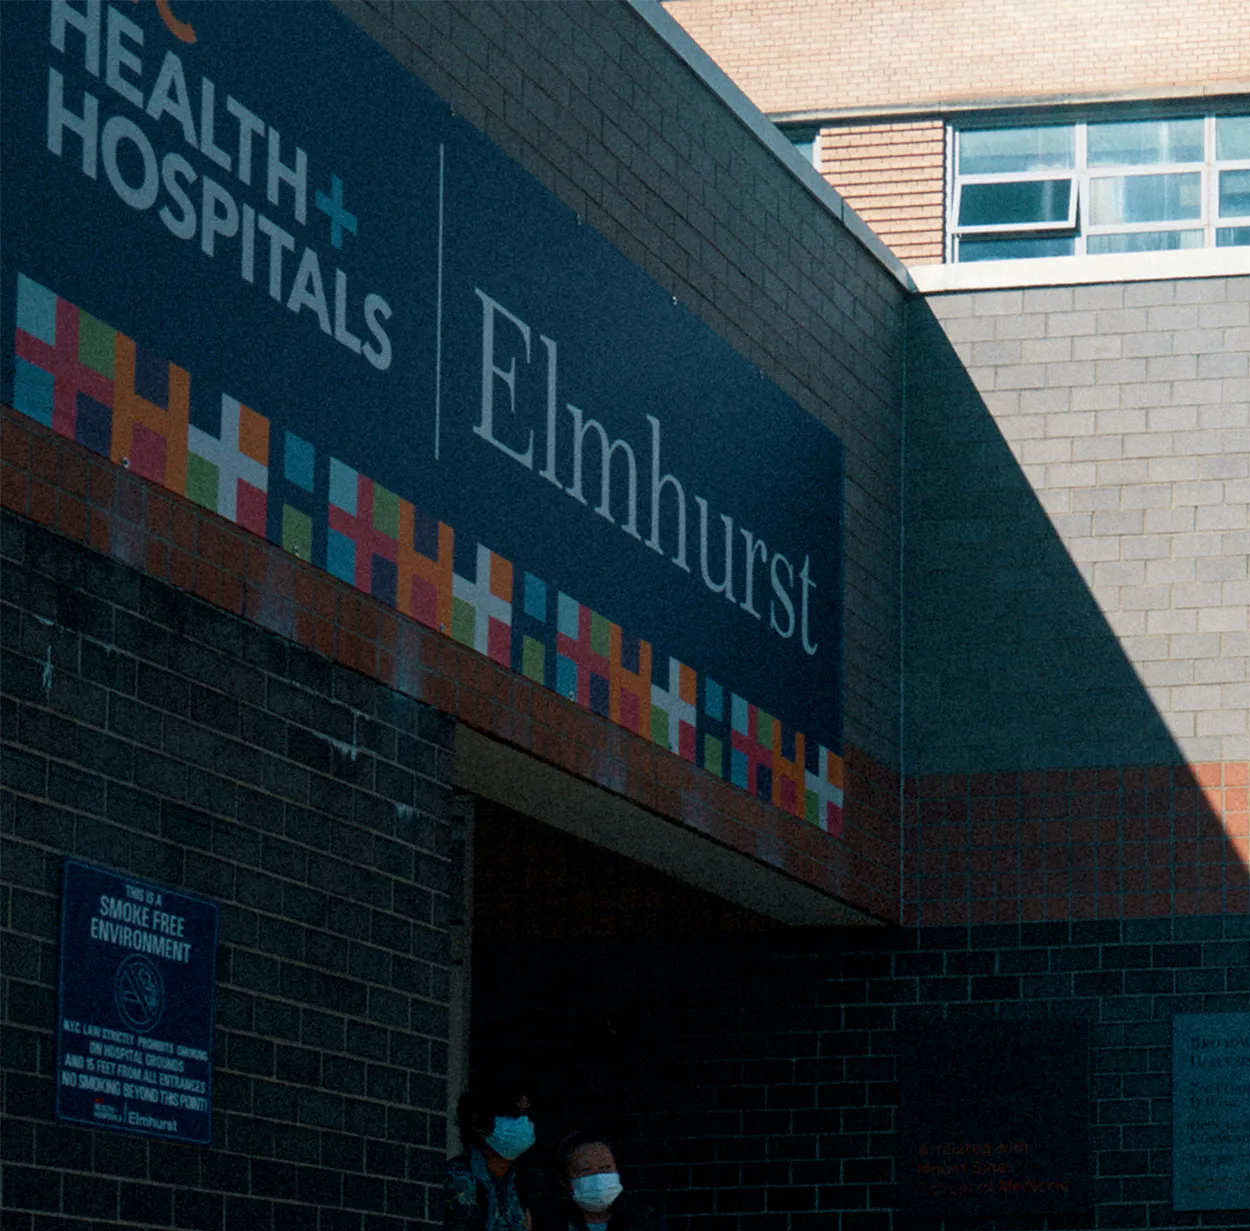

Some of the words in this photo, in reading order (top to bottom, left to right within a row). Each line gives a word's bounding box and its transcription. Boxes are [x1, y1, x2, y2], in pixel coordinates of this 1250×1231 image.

[47, 66, 393, 371] HOSPITALS
[472, 287, 819, 656] Elmhurst
[99, 894, 150, 928] SMOKE
[152, 910, 185, 938] FREE
[125, 884, 145, 902] THIS
[145, 889, 155, 905] IS
[155, 893, 163, 907] A
[90, 916, 192, 964] ENVIRONMENT
[64, 1053, 85, 1069] AND
[86, 1057, 95, 1071] 15
[96, 1059, 117, 1076] FEET
[117, 1063, 142, 1081] FROM
[142, 1069, 158, 1085] ALL
[158, 1073, 206, 1094] ENTRANCES
[103, 1044, 144, 1065] HOSPITAL
[145, 1053, 185, 1073] GROUNDS
[62, 1070, 77, 1087] NO
[78, 1073, 121, 1096] SMOKING
[122, 1082, 159, 1103] BEYOND
[159, 1090, 179, 1108] THIS
[128, 1111, 178, 1132] Elmhurst
